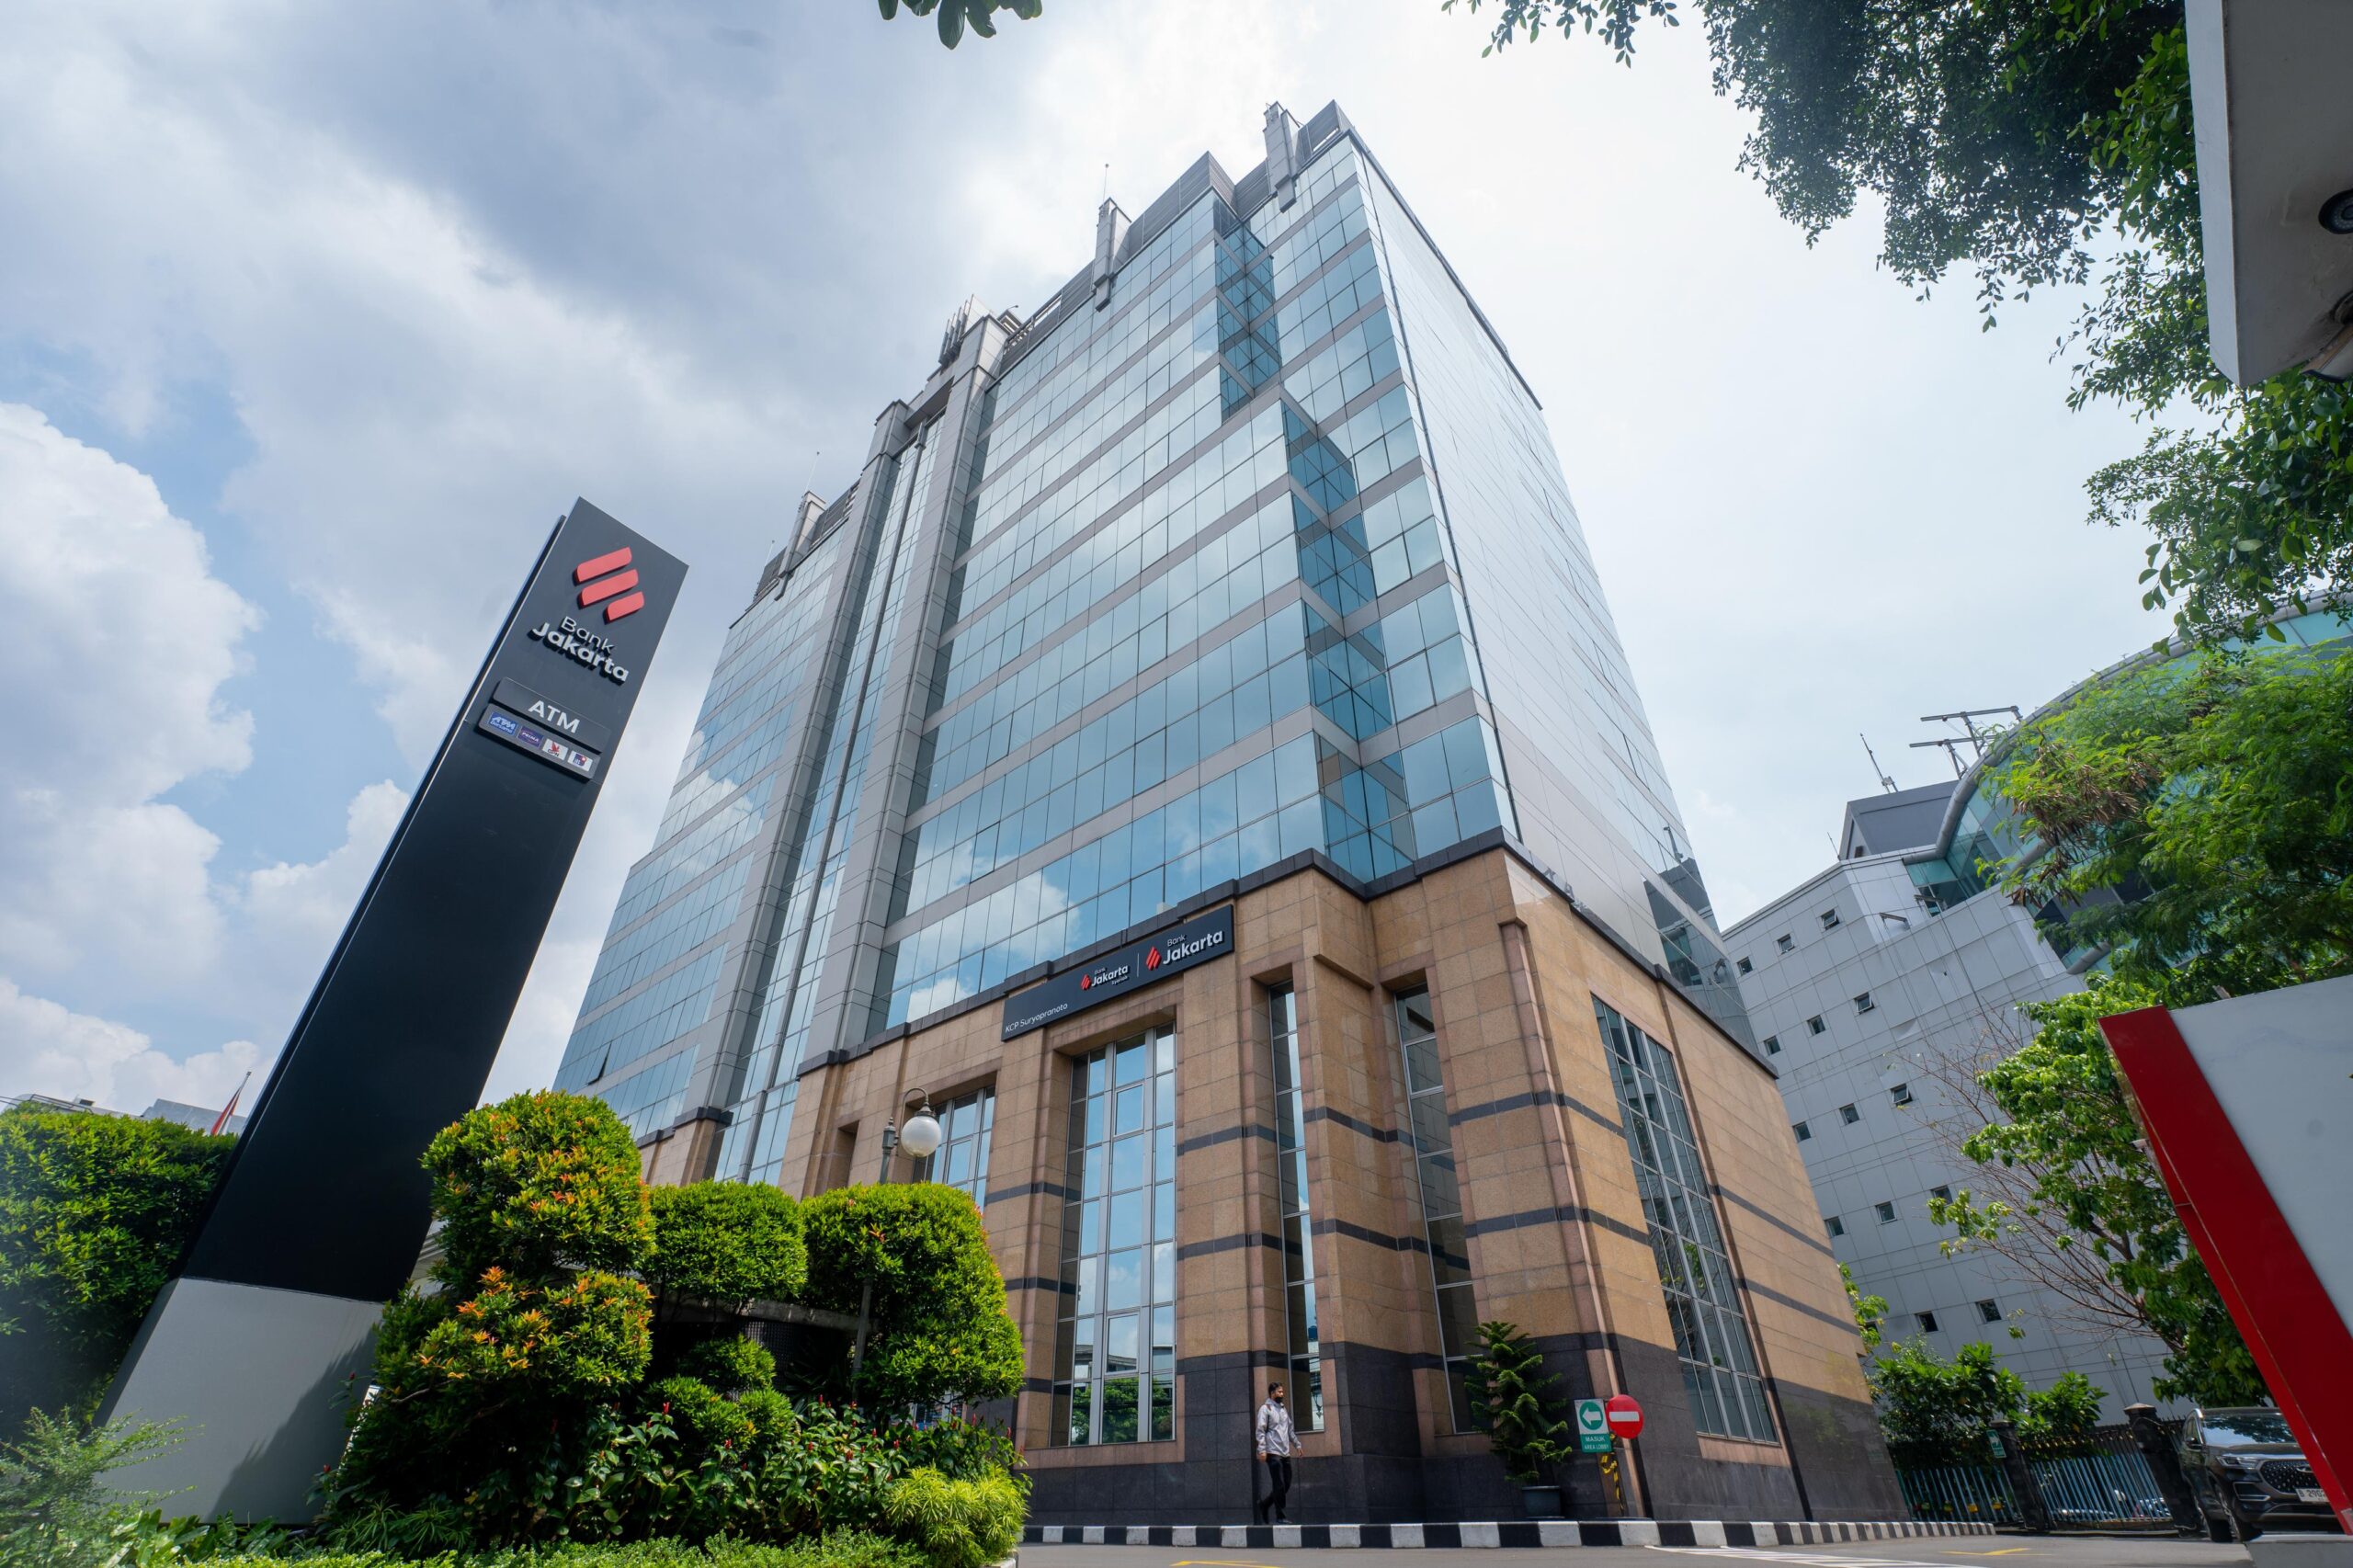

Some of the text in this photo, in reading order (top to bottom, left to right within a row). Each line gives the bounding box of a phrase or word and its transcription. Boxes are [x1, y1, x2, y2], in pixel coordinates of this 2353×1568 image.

[561, 616, 614, 654] Bank
[532, 622, 630, 682] Jakarta
[528, 699, 581, 733] ATM
[1163, 930, 1223, 965] Jakarta
[1167, 935, 1186, 948] Bank
[1091, 965, 1129, 987] Jakarta
[1005, 1003, 1068, 1033] KCP Suryopranoto
[2299, 1489, 2304, 1497] B
